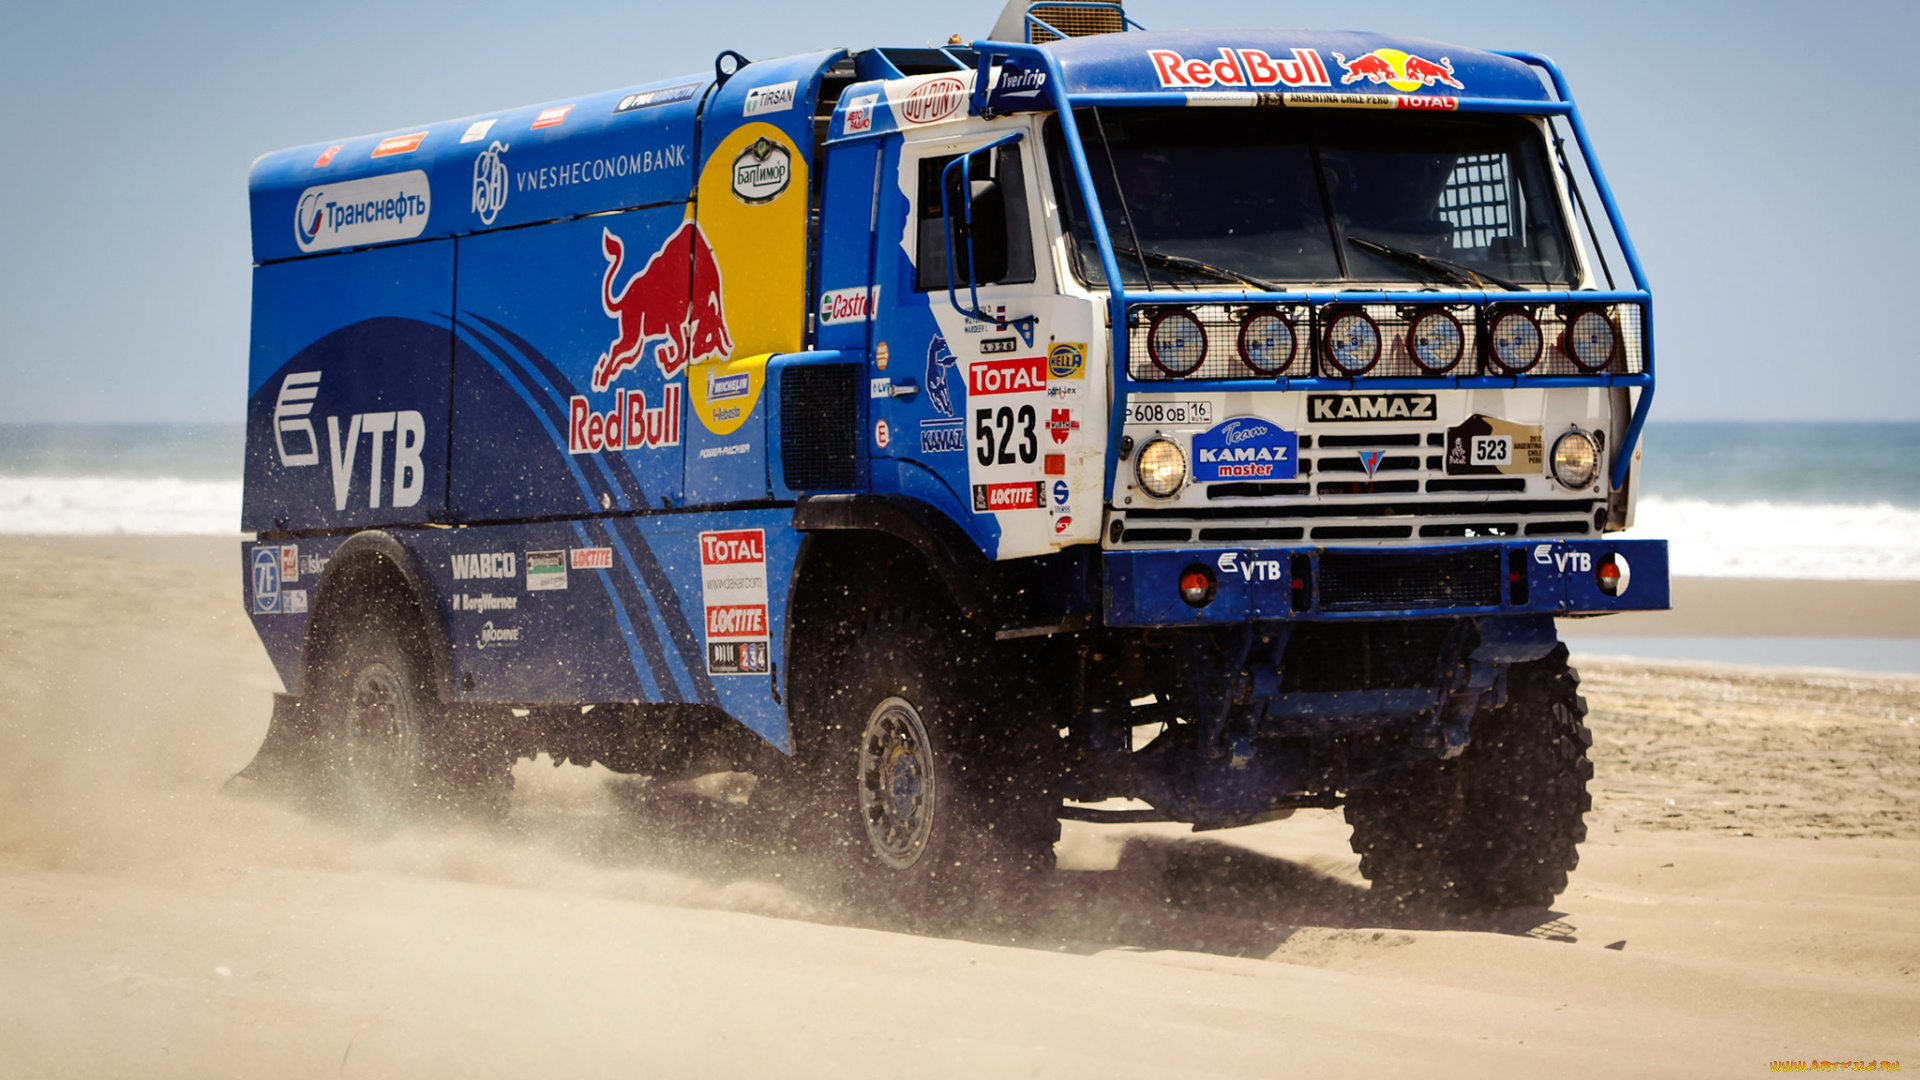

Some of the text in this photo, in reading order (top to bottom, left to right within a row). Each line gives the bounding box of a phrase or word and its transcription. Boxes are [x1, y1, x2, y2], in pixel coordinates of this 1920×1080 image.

[1149, 47, 1331, 87] Red Bull
[1002, 68, 1046, 89] TverTrip
[1290, 94, 1339, 104] ARGENTINA
[1340, 95, 1364, 105] CHILE
[1366, 95, 1389, 105] PERU
[1402, 95, 1453, 108] TOTAL
[516, 143, 687, 193] VNESHECONOMBANK
[325, 191, 426, 233] Транснефть
[1050, 354, 1081, 368] HELLA
[714, 378, 748, 393] MICHELIN
[971, 366, 1046, 392] TOTAL
[568, 382, 682, 455] Red Bull
[1314, 397, 1432, 419] KAMAZ
[921, 429, 963, 452] KAMAZ
[976, 404, 1038, 467] 523
[1222, 421, 1267, 445] Team
[326, 409, 427, 511] VTB
[699, 443, 750, 458] POWER-PACKER
[1199, 447, 1288, 463] KAMAZ
[1477, 440, 1507, 460] 523
[1218, 463, 1273, 477] master
[990, 487, 1033, 505] LOCTITE
[572, 550, 611, 567] LOCTITE
[703, 536, 762, 561] TOTAL
[451, 552, 516, 580] WABCO
[1240, 560, 1281, 580] VTB
[1554, 553, 1591, 573] VTB
[462, 593, 518, 614] BorgWarner
[710, 609, 762, 633] LOCTITE
[481, 629, 519, 642] MODINE
